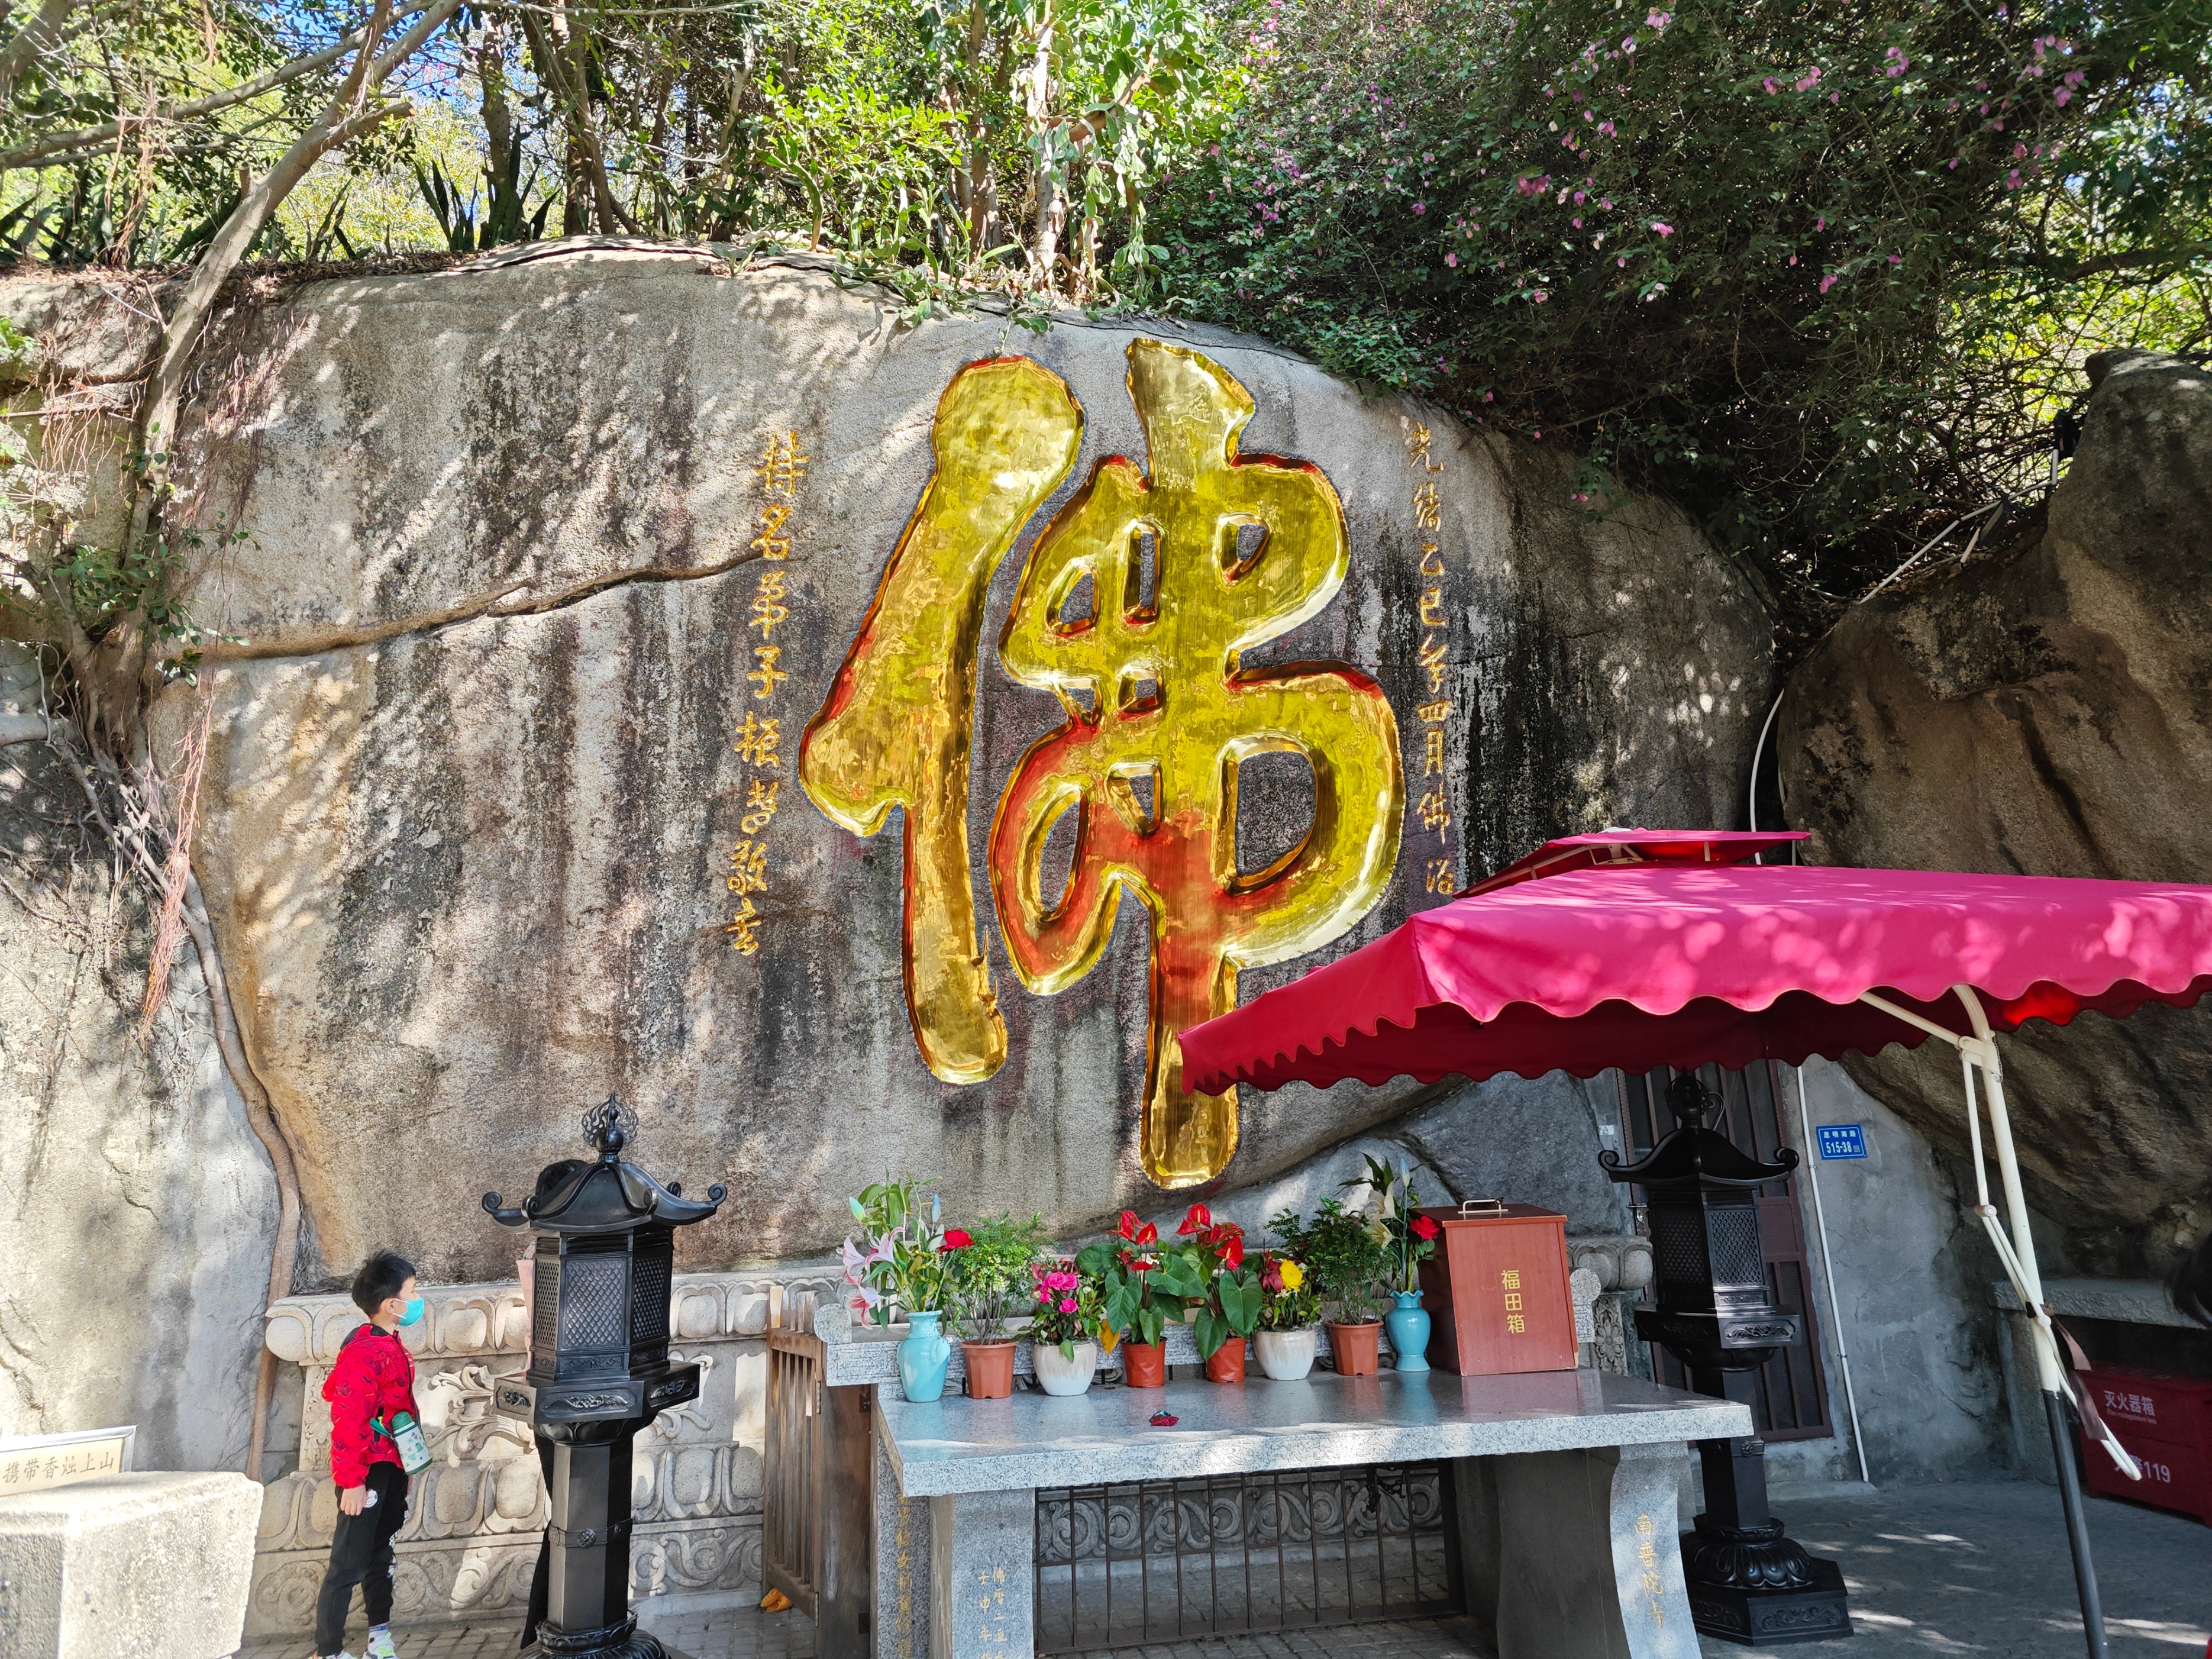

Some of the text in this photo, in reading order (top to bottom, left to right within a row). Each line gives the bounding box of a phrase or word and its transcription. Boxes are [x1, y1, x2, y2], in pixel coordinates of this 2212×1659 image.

[799, 337, 1404, 1189] 佛
[1823, 1130, 1856, 1138] 思明南路
[1826, 1141, 1852, 1154] 515-38
[1501, 1270, 1525, 1334] 福田箱
[2104, 1390, 2155, 1416] 灭火器箱
